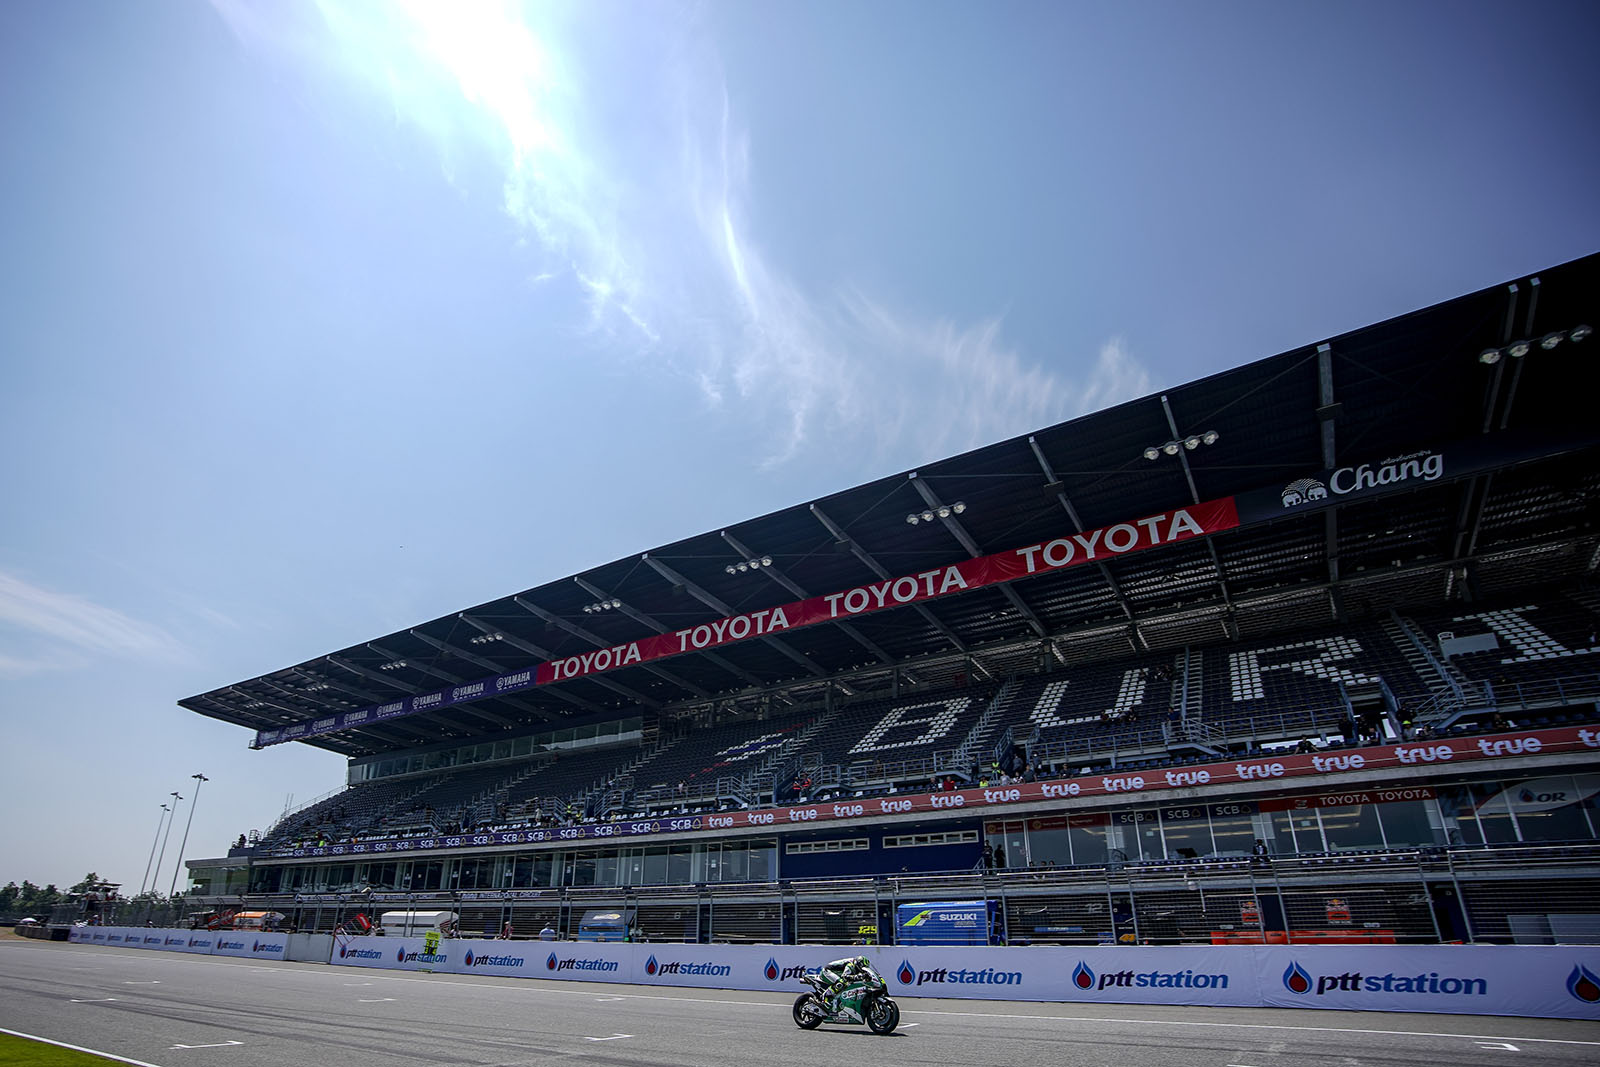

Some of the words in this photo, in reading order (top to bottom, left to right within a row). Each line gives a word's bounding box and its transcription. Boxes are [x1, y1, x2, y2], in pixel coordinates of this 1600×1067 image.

[1329, 454, 1444, 495] Chang
[1016, 509, 1204, 573] TOYOTA
[823, 565, 968, 618] TOYOTA
[676, 607, 790, 652] TOYOTA
[551, 642, 642, 680] TOYOTA
[504, 671, 530, 686] YAMAHA
[460, 682, 484, 697] YAMAHA
[419, 692, 442, 706] YAMAHA
[382, 701, 403, 714] YAMAHA
[1477, 737, 1542, 756] true
[1395, 745, 1453, 763] true
[1312, 754, 1365, 772] true
[1235, 762, 1284, 779] true
[1102, 776, 1144, 792] true
[1165, 770, 1210, 786] true
[983, 788, 1020, 803] true
[1041, 782, 1080, 798] true
[930, 794, 964, 808] true
[1319, 793, 1370, 806] TOYOTA
[1376, 789, 1432, 802] TOYOTA
[1537, 792, 1566, 803] OR
[833, 803, 863, 817] true
[880, 799, 912, 812] true
[1215, 805, 1241, 817] SCB
[747, 812, 774, 825] true
[789, 808, 817, 821] true
[1120, 813, 1145, 824] SCB
[1167, 809, 1191, 820] SCB
[631, 822, 651, 833] SCB
[670, 819, 692, 831] SCB
[708, 816, 734, 828] true
[527, 832, 545, 842] SCB
[560, 829, 578, 839] SCB
[594, 826, 613, 836] SCB
[420, 839, 434, 849] SCB
[446, 837, 460, 847] SCB
[473, 835, 488, 845] SCB
[502, 833, 518, 843] SCB
[332, 846, 344, 855] SCB
[353, 844, 365, 853] SCB
[374, 843, 387, 852] SCB
[396, 841, 409, 851] SCB
[939, 913, 977, 921] SUZUKI
